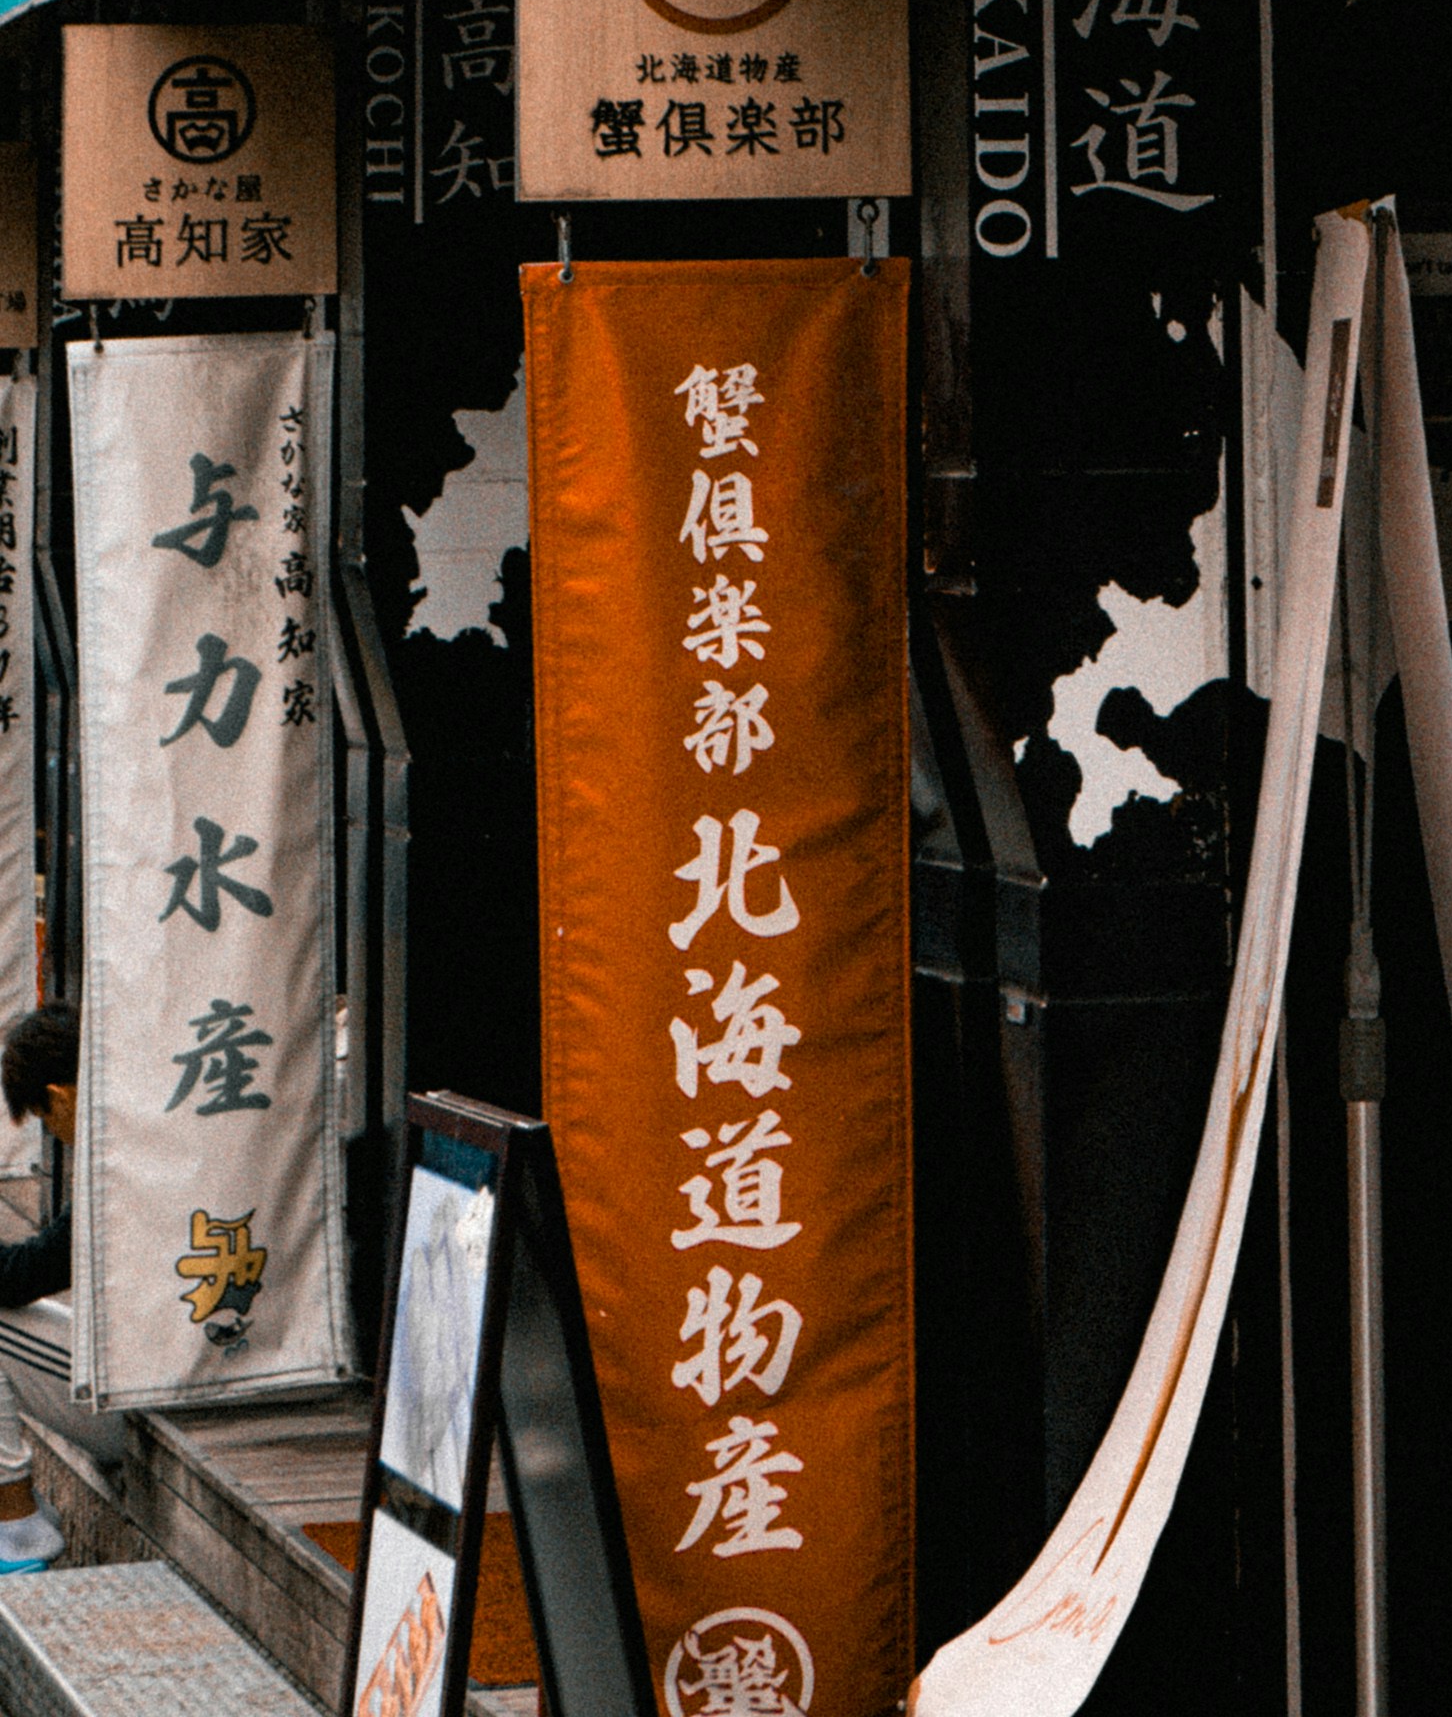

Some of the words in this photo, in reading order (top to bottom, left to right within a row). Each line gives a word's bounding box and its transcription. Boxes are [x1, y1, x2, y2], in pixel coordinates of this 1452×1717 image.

[364, 3, 407, 207] KOCHI
[634, 51, 804, 86] 北海道物産
[114, 213, 293, 270] 高知家
[140, 174, 264, 205] さかな屋
[151, 451, 276, 1117] 与力水産
[668, 807, 805, 1559] 北海道物産
